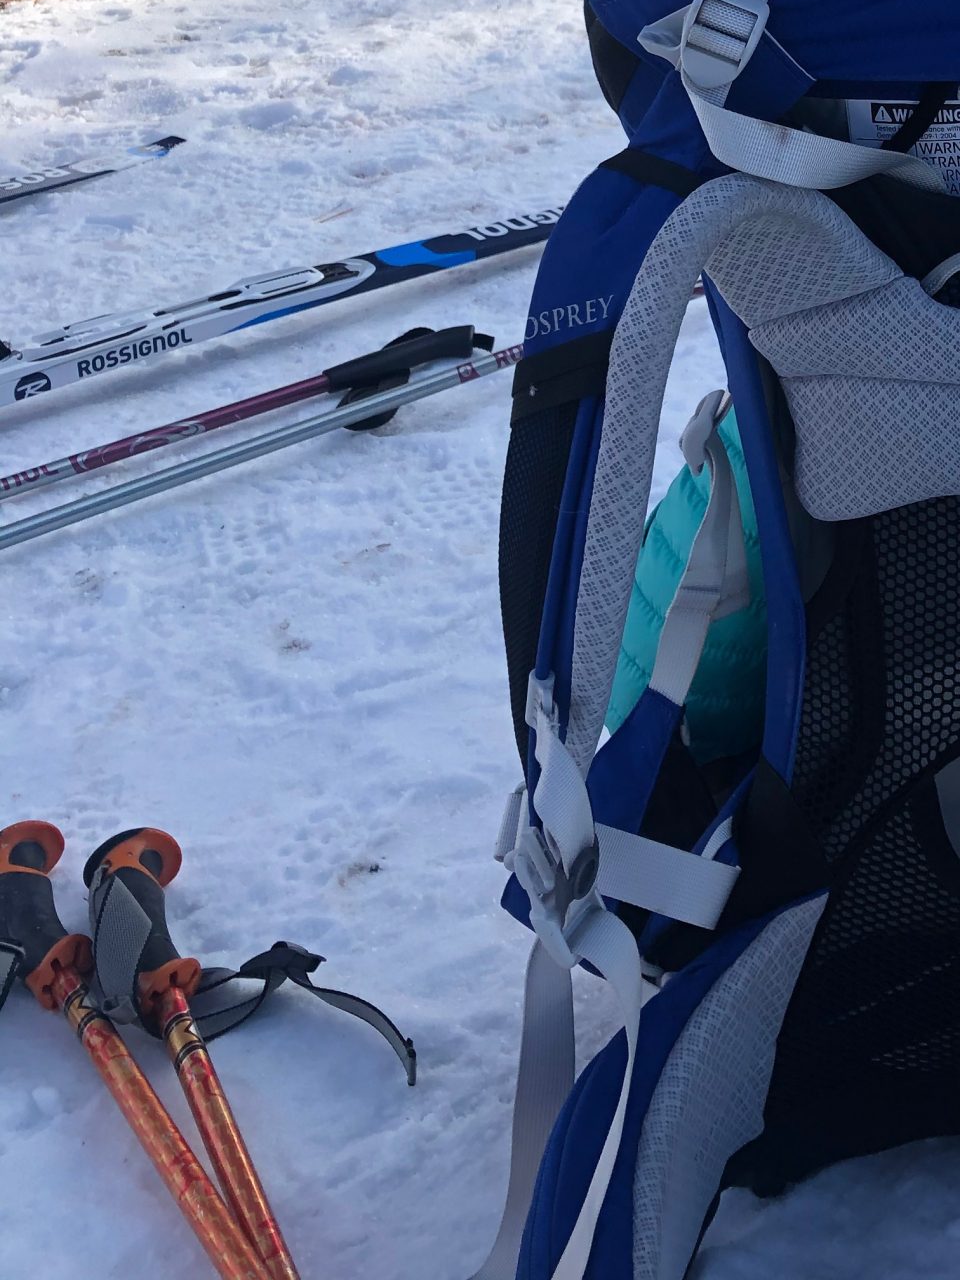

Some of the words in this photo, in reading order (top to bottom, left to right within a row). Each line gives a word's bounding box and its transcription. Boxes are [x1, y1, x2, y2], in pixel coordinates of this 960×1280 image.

[875, 124, 897, 132] Tested
[524, 294, 615, 340] OSPREY
[76, 327, 193, 378] ROSSIGNOL
